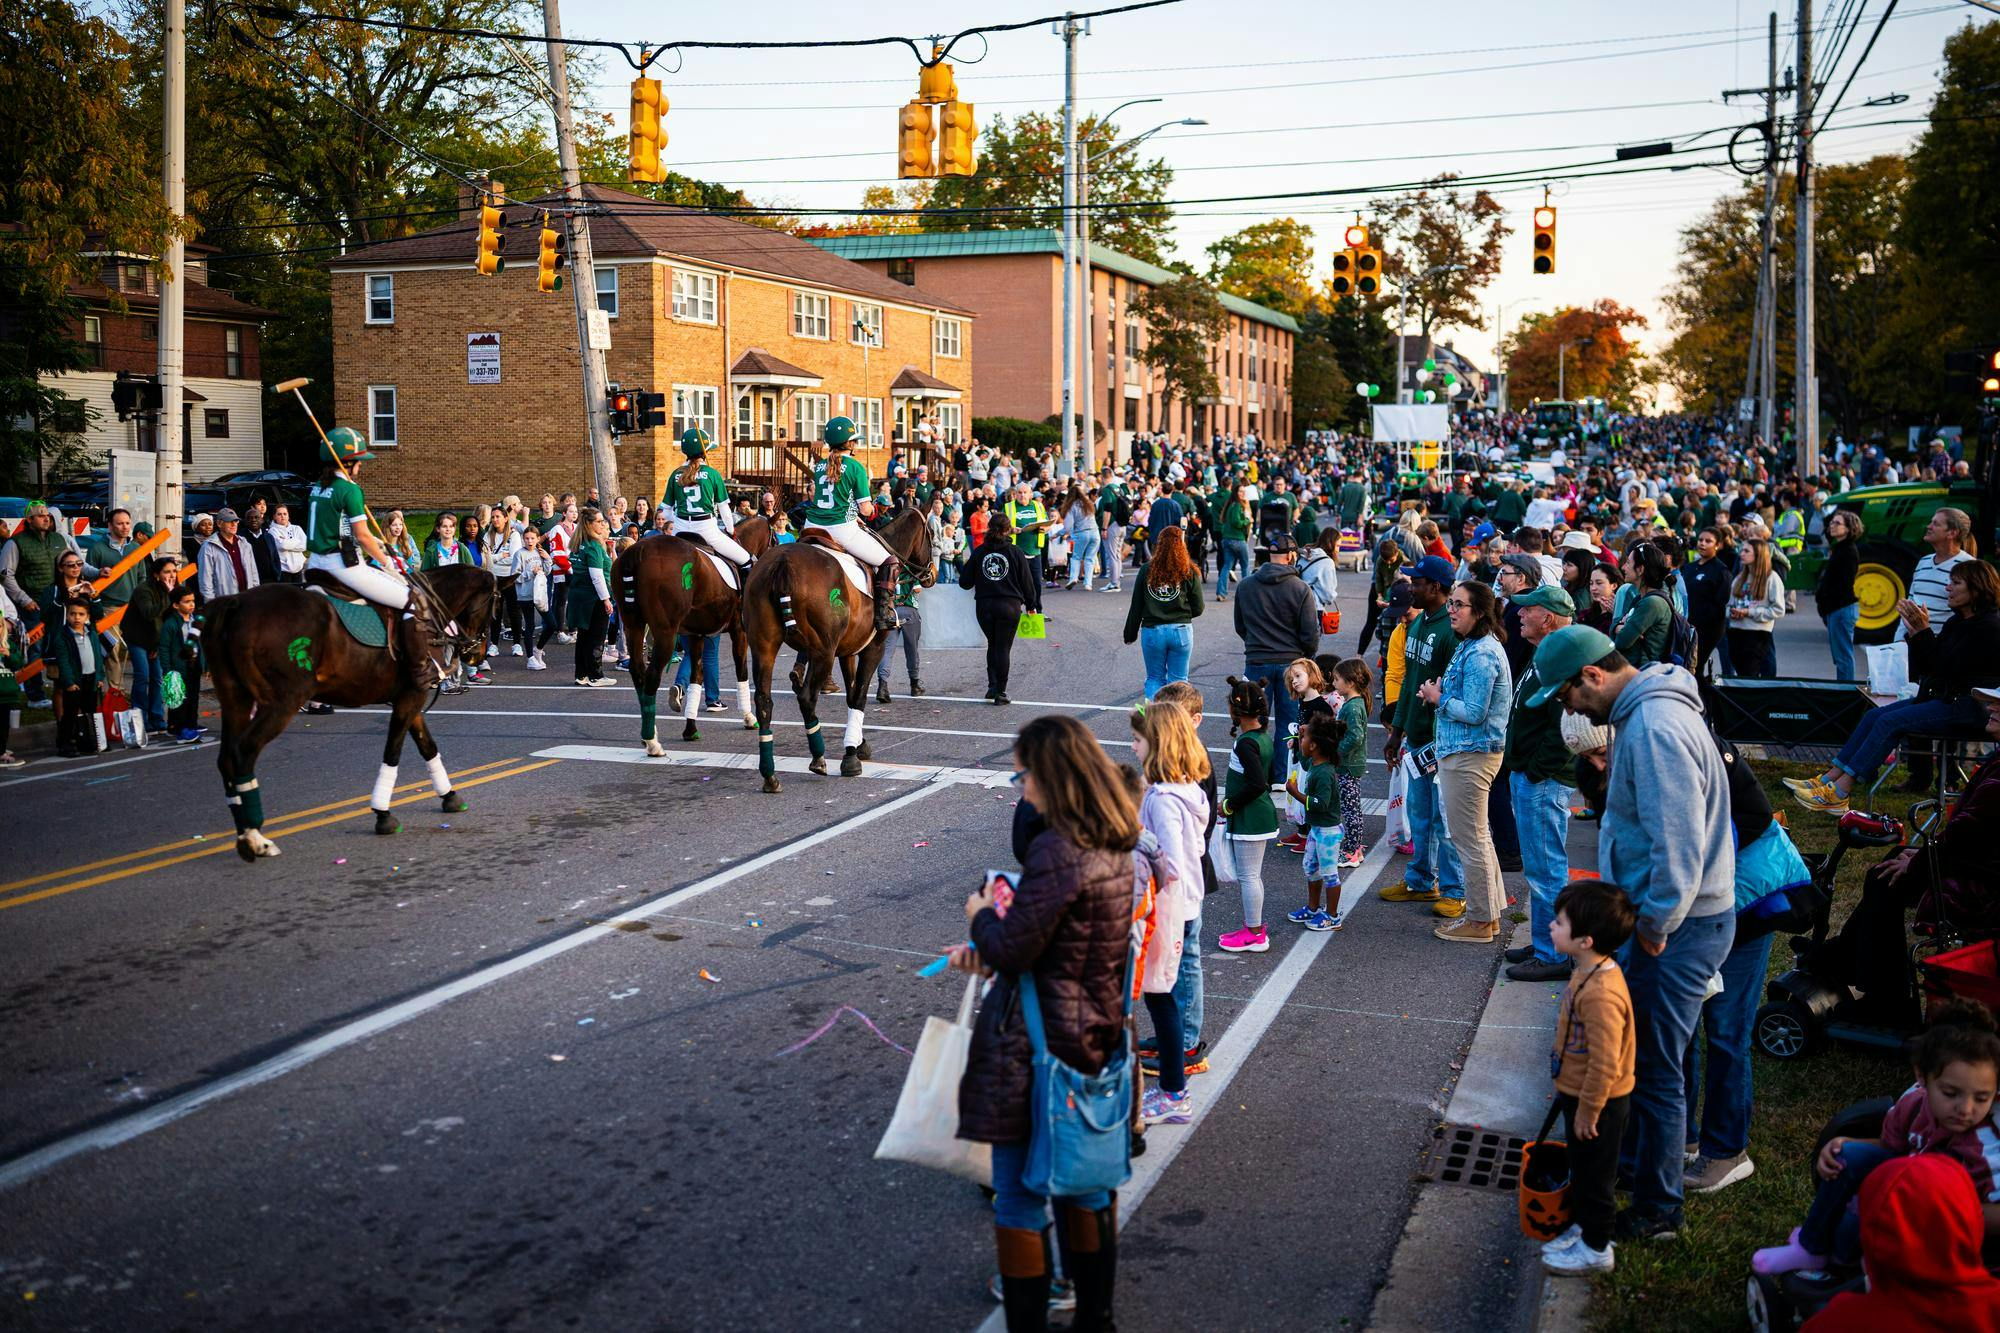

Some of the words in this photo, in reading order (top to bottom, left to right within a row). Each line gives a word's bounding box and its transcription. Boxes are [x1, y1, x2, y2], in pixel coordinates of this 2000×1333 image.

[683, 485, 705, 513] 2
[817, 475, 835, 509] 3
[309, 501, 317, 541] 1
